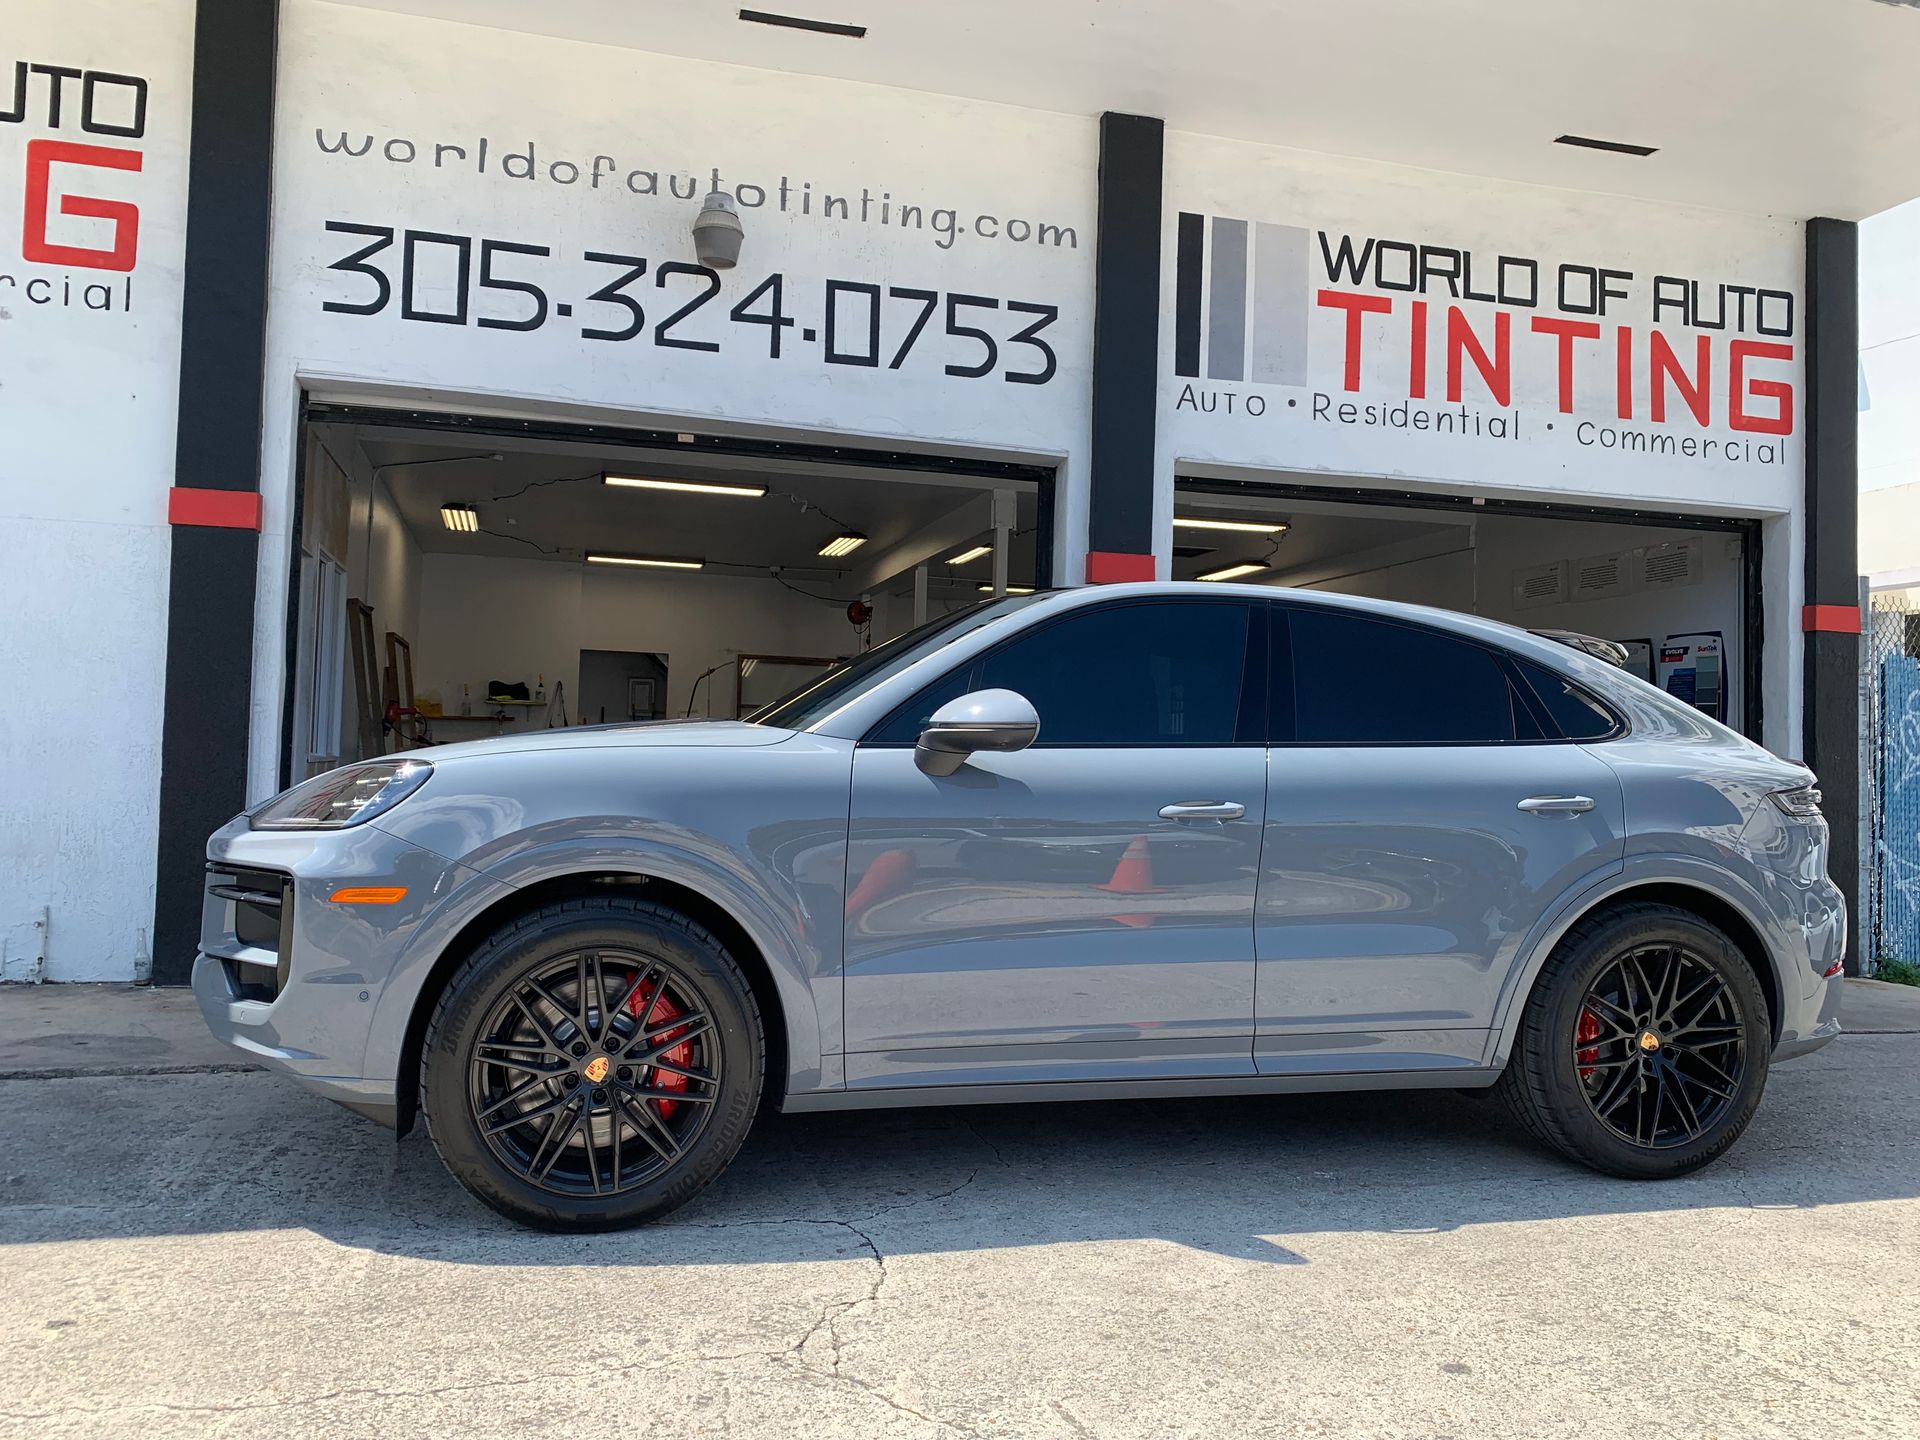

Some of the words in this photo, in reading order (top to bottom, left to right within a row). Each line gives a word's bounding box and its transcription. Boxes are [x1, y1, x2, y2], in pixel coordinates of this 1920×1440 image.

[23, 139, 143, 273] G
[316, 128, 1077, 250] worldofautotinting.com
[323, 221, 1058, 386] 305.324.0753
[1318, 231, 1538, 308] WORLD
[1558, 264, 1634, 316] OF
[1653, 276, 1793, 338] AUTO
[1317, 289, 1794, 436] TINTING
[1313, 392, 1519, 441] Residential
[1577, 421, 1786, 465] Commercial
[658, 1088, 751, 1204] BRIDGESTONE
